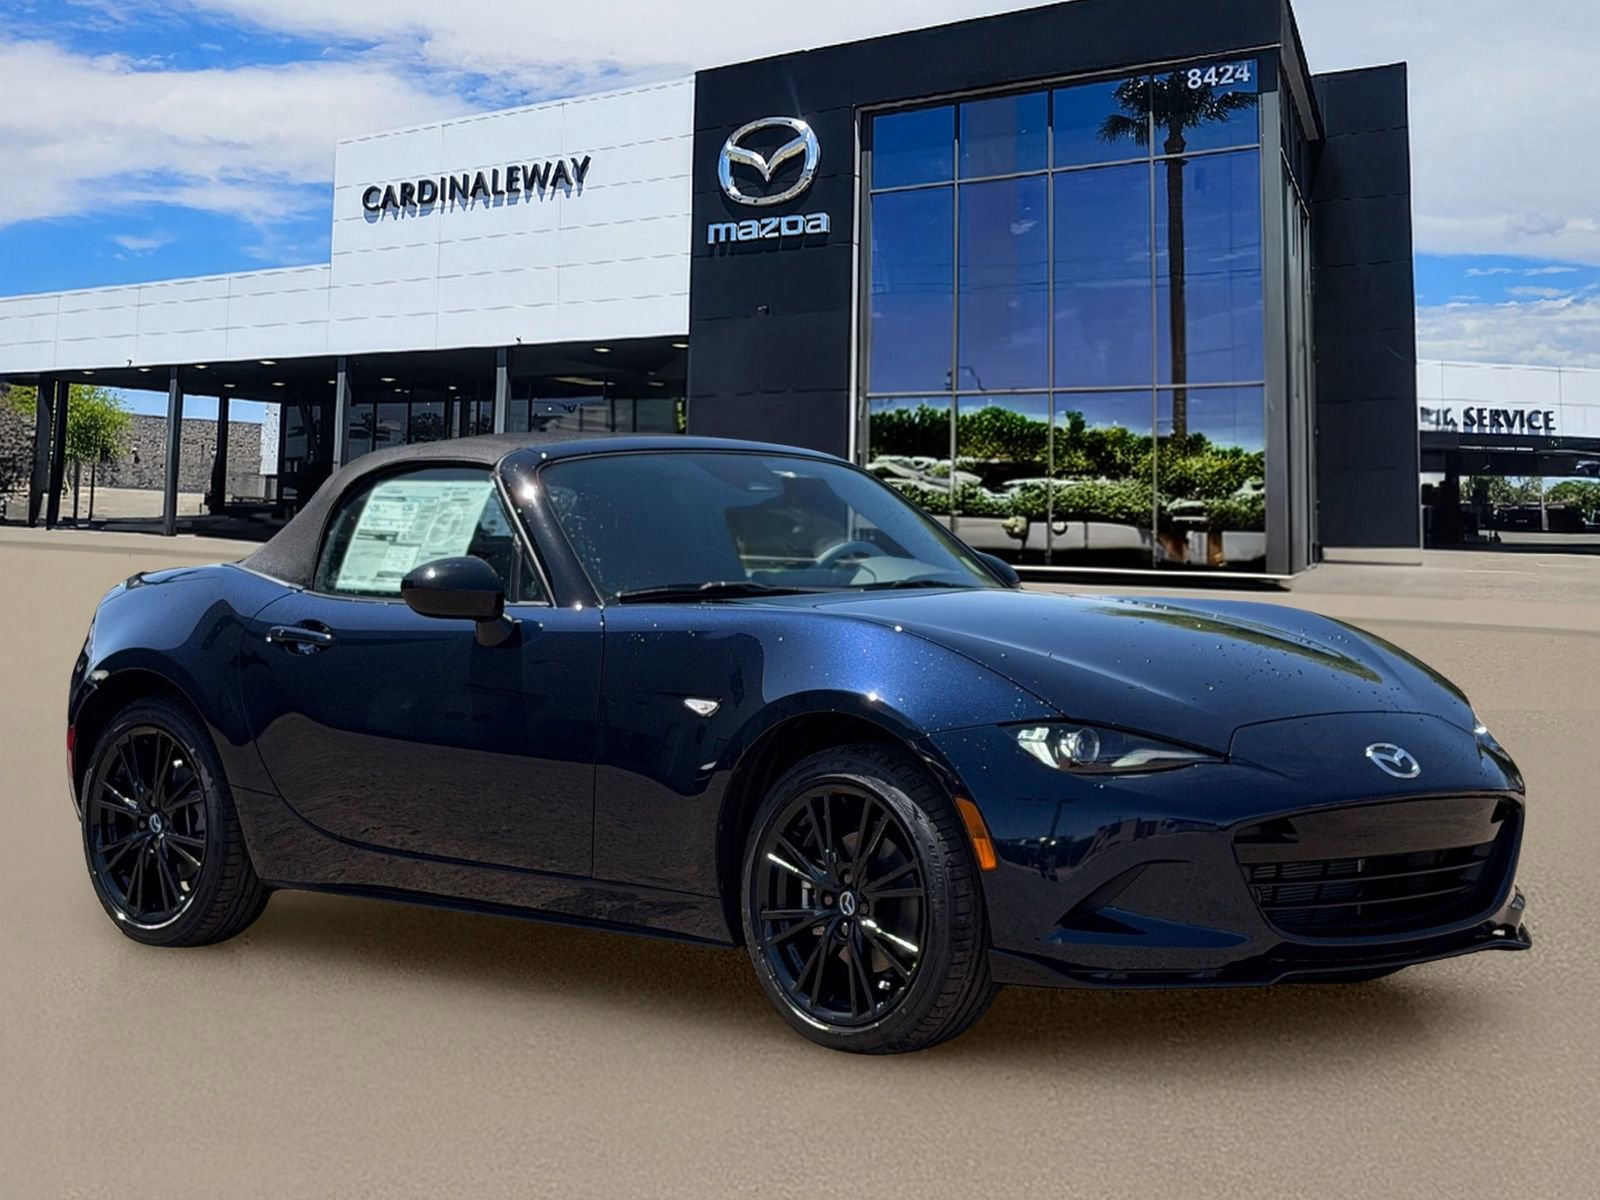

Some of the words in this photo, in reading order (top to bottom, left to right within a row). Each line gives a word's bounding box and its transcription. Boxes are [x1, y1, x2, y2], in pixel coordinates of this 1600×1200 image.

[1187, 63, 1251, 90] 8424
[362, 155, 592, 212] CARDINALEWAY
[707, 212, 831, 245] mazda
[1463, 406, 1557, 431] SERVICE
